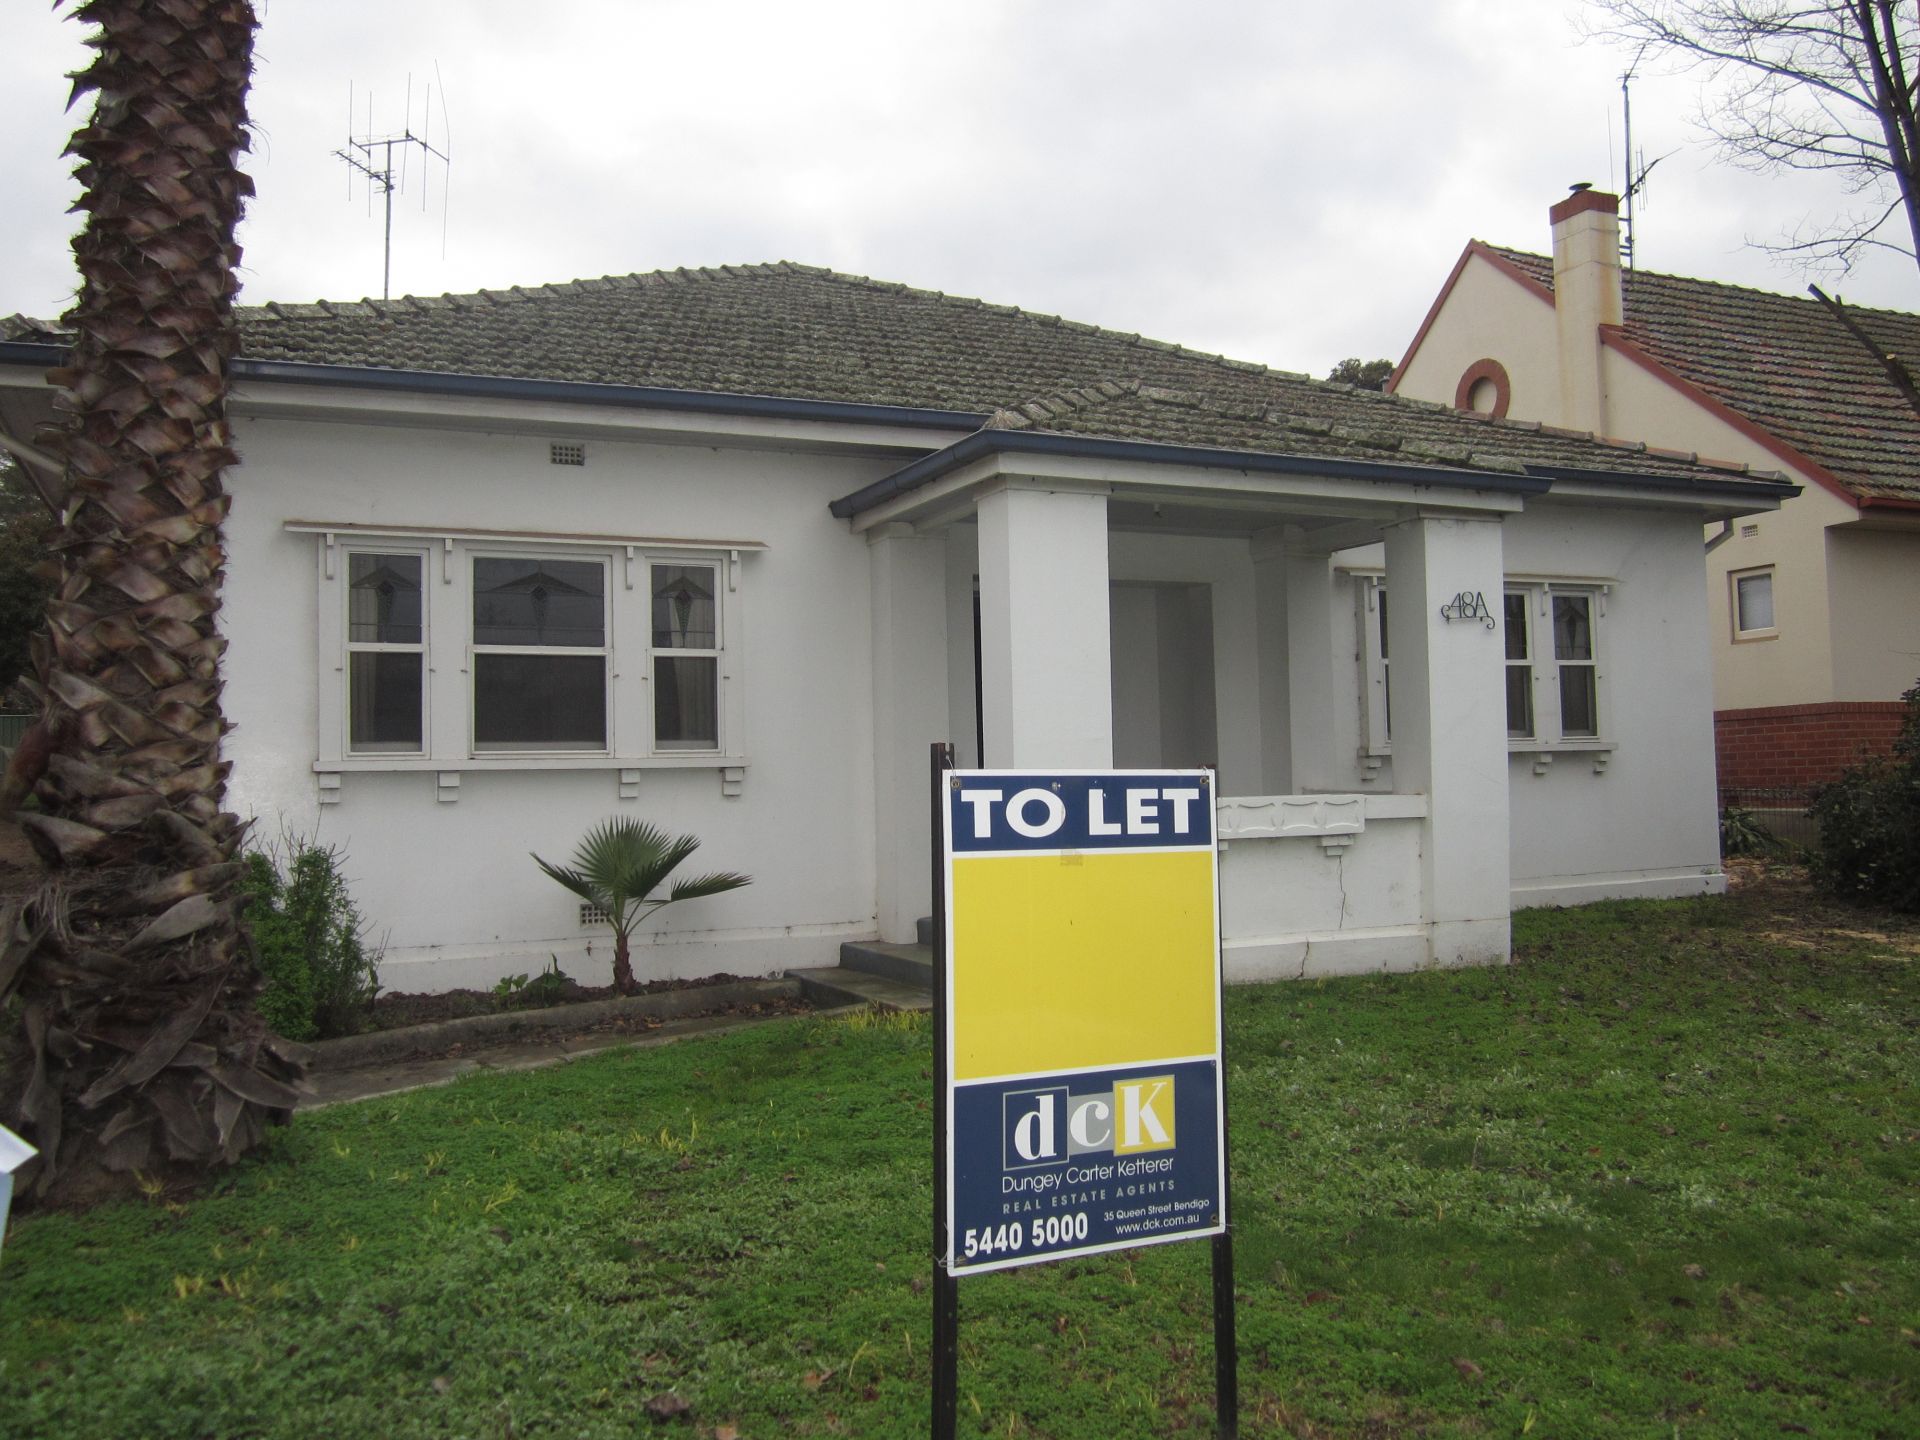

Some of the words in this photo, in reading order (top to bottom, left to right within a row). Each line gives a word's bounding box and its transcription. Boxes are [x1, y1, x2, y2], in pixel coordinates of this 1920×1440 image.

[1450, 591, 1489, 618] 48A
[961, 788, 1066, 838] TO
[1088, 788, 1199, 836] LET
[1002, 1173, 1062, 1193] Dungey
[1066, 1165, 1113, 1183] Carter
[1117, 1157, 1174, 1176] Ketterer
[1003, 1198, 1041, 1214] REAL
[1052, 1190, 1106, 1208] ESTATE
[1116, 1180, 1175, 1198] AGENTS
[1103, 1211, 1115, 1221] 35
[1116, 1207, 1146, 1220] Queen
[1147, 1203, 1171, 1215] Street
[1174, 1199, 1210, 1212] Bendigo
[964, 1222, 1023, 1258] 5440
[1031, 1212, 1088, 1247] 5000
[1115, 1214, 1200, 1235] www.dck.com.au
